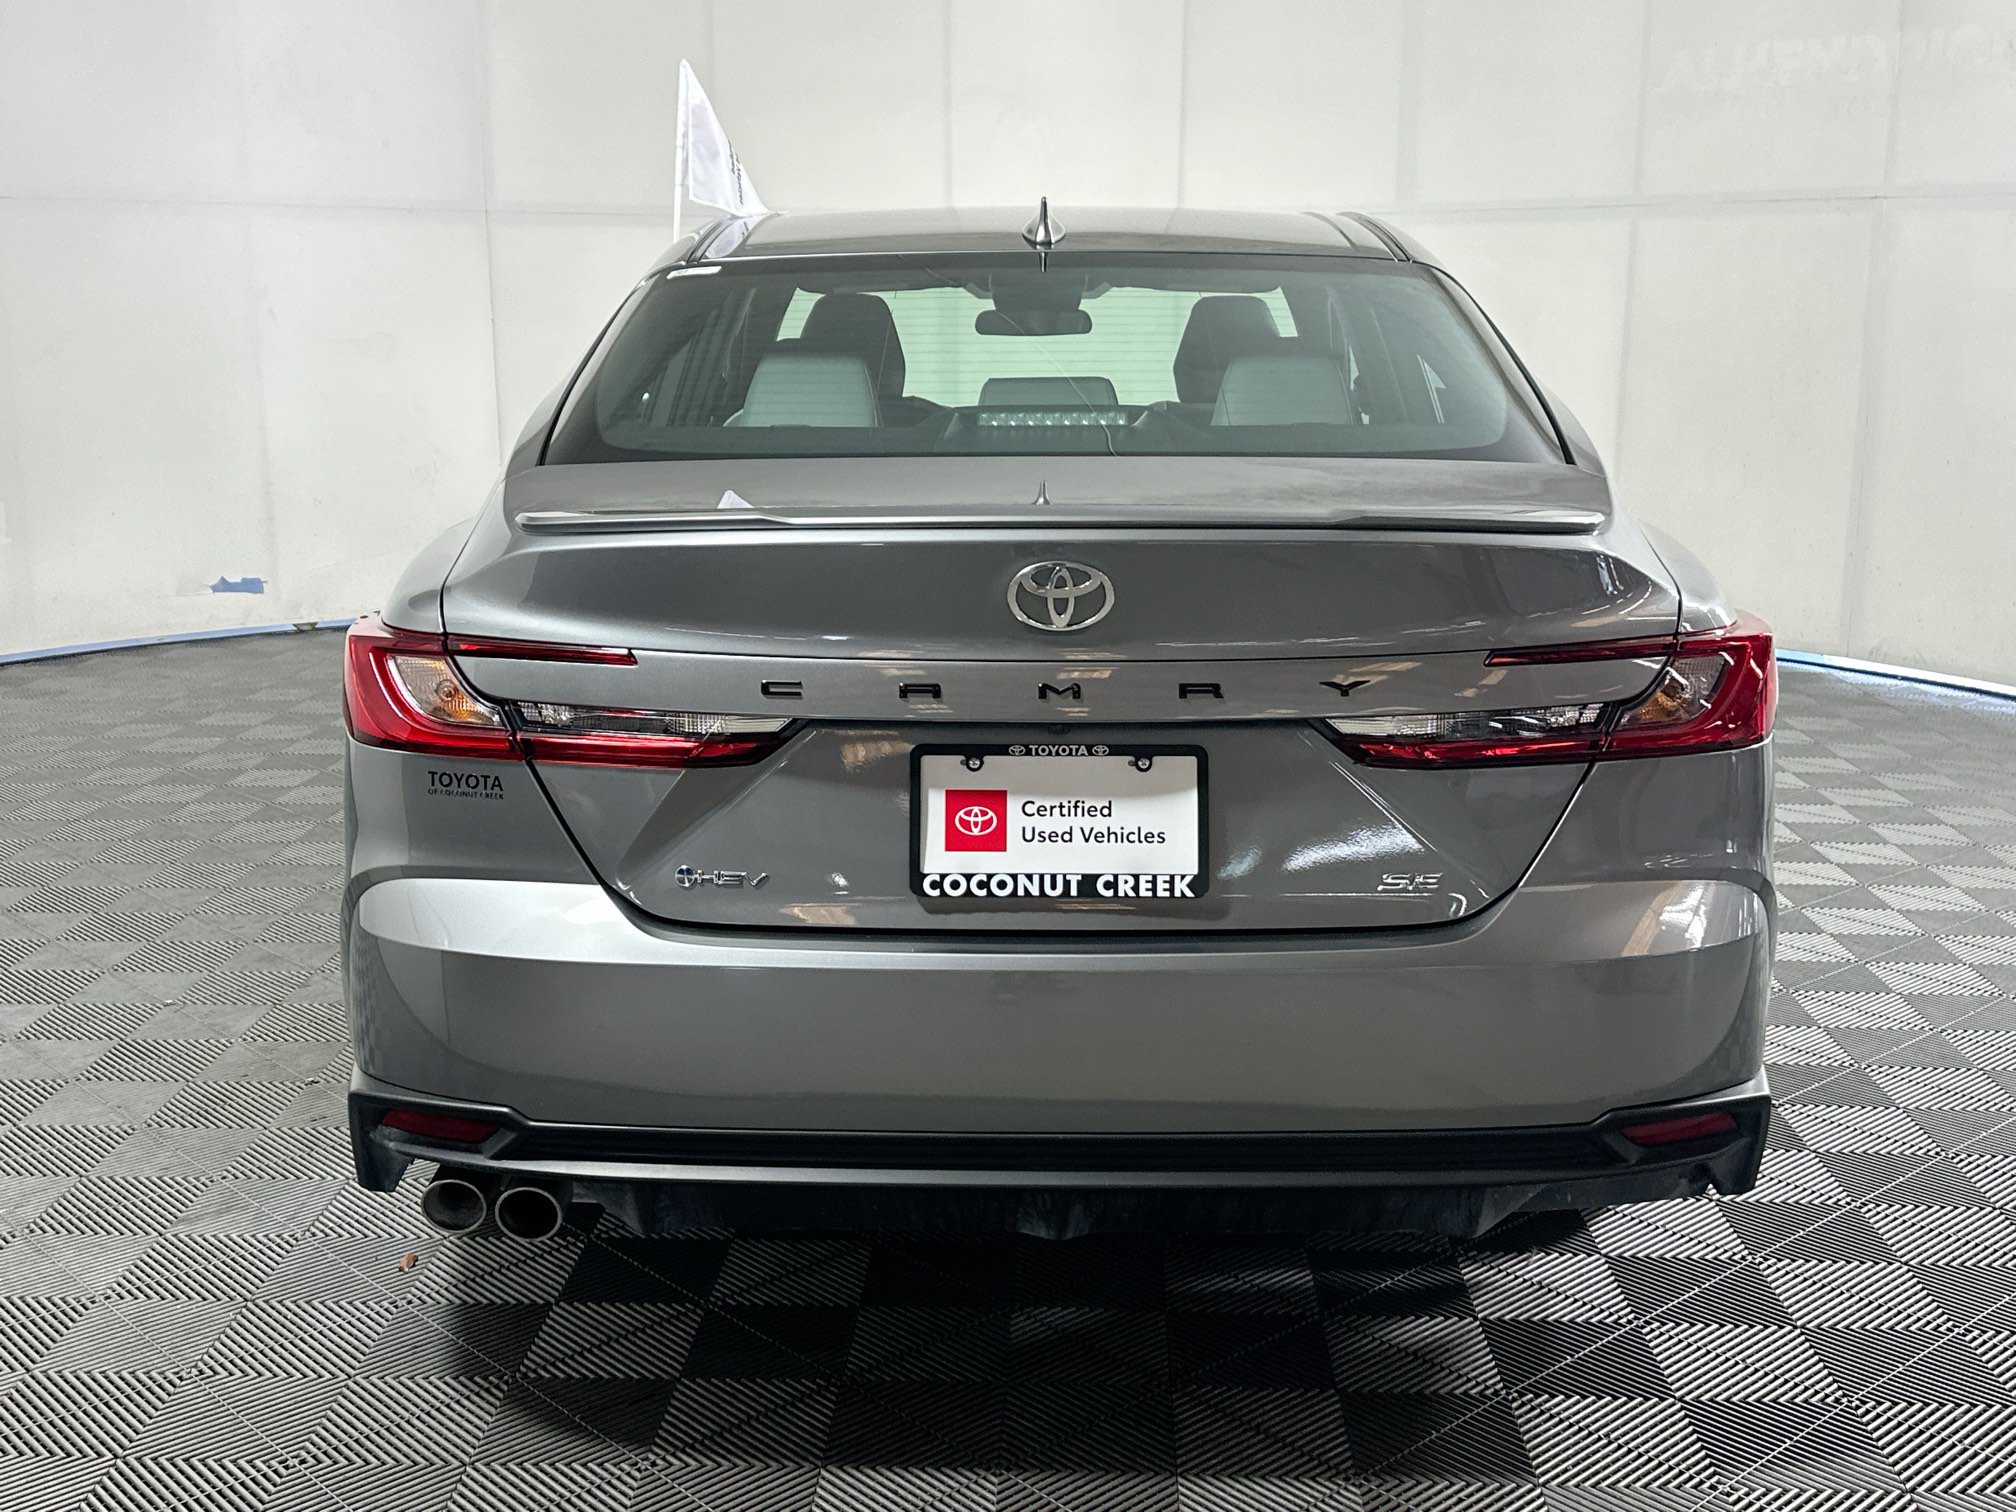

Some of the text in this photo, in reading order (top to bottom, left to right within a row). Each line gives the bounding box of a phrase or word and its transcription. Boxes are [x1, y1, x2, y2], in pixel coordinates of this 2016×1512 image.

[760, 679, 1371, 700] CAMRY
[1028, 745, 1089, 756] TOYOTA
[428, 770, 503, 792] TOYOTA
[479, 791, 504, 801] CREEK
[1021, 800, 1113, 818] Certified
[1021, 826, 1167, 844] Used Vehicles
[695, 869, 767, 886] HEV
[922, 874, 1195, 897] COCONUT CREEK
[1377, 872, 1444, 891] SE
